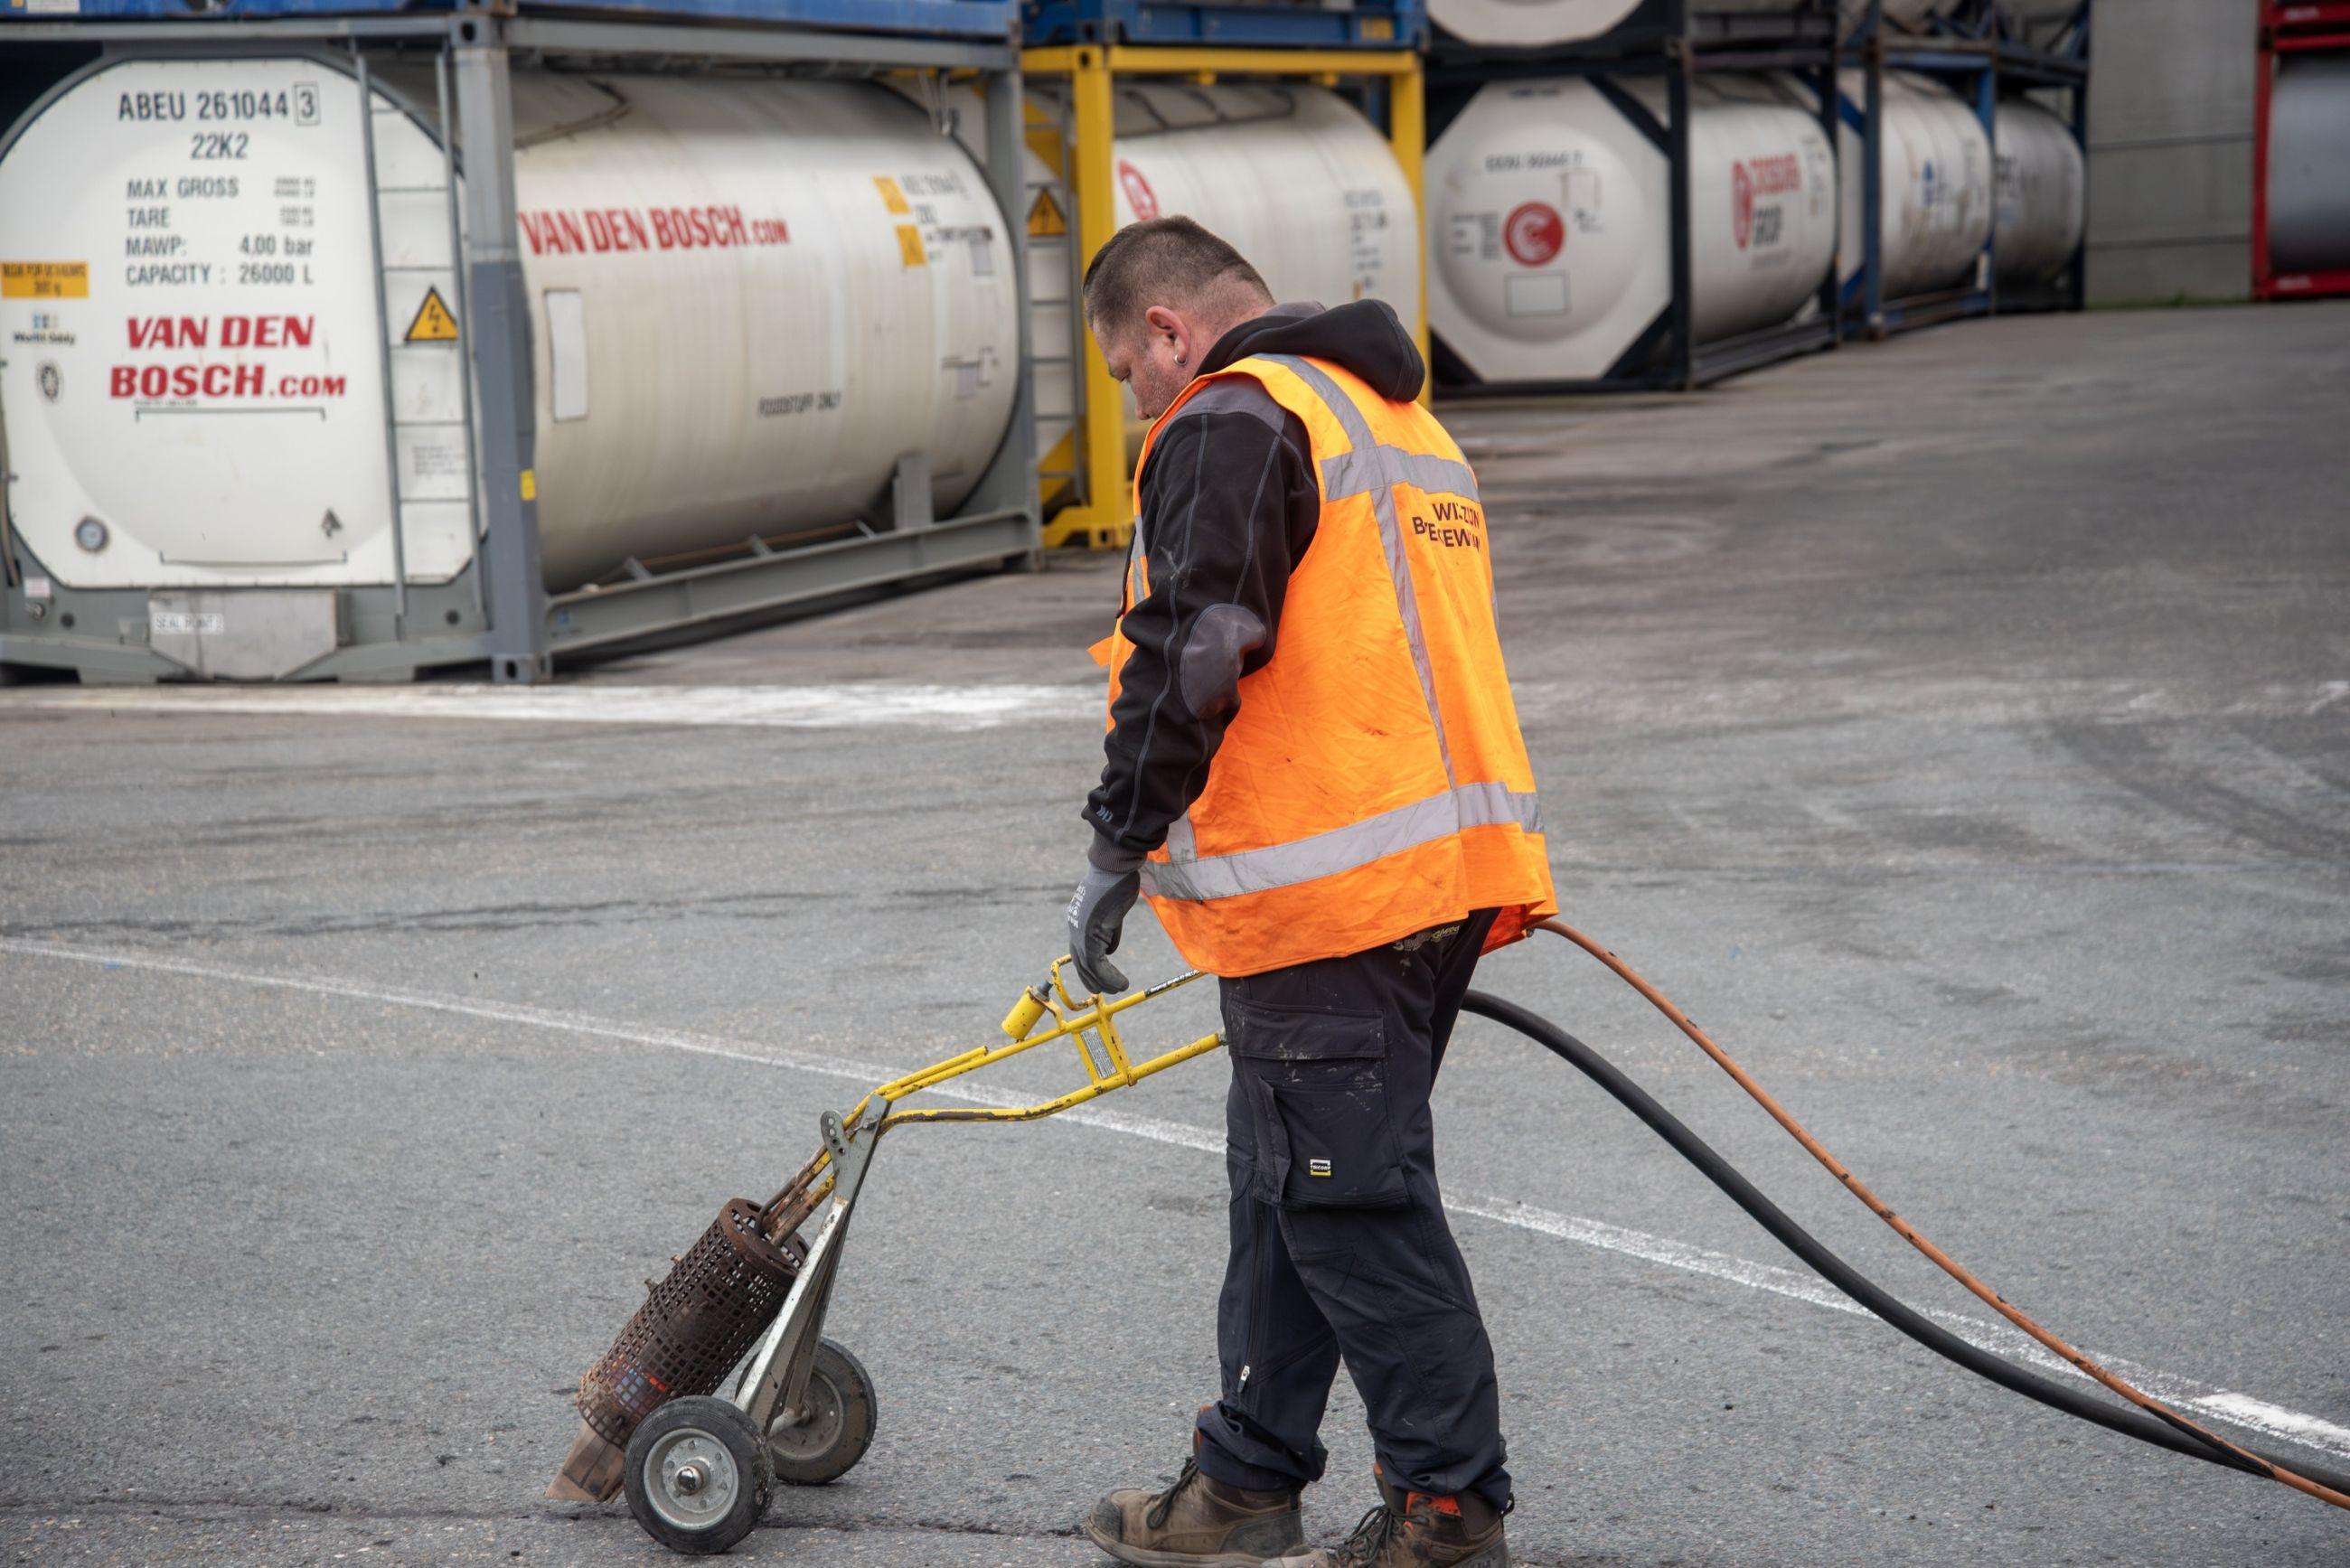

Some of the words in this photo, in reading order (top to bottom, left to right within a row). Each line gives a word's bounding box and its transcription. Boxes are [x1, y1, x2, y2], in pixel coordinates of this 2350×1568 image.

[118, 92, 185, 121] ABEU
[197, 90, 288, 120] 261044
[300, 91, 315, 118] 3
[191, 132, 249, 160] 22K2
[127, 179, 168, 199] MAX
[177, 177, 240, 198] GROSS
[127, 208, 170, 229] TARE
[520, 209, 586, 256] VAN
[584, 208, 649, 253] DEN
[284, 236, 314, 256] bar
[126, 264, 212, 286] CAPACITY
[240, 263, 295, 285] 26000
[303, 264, 314, 285] L
[127, 315, 209, 350] VAN
[220, 315, 315, 348] DEN
[109, 363, 347, 399] BOSCH.COM
